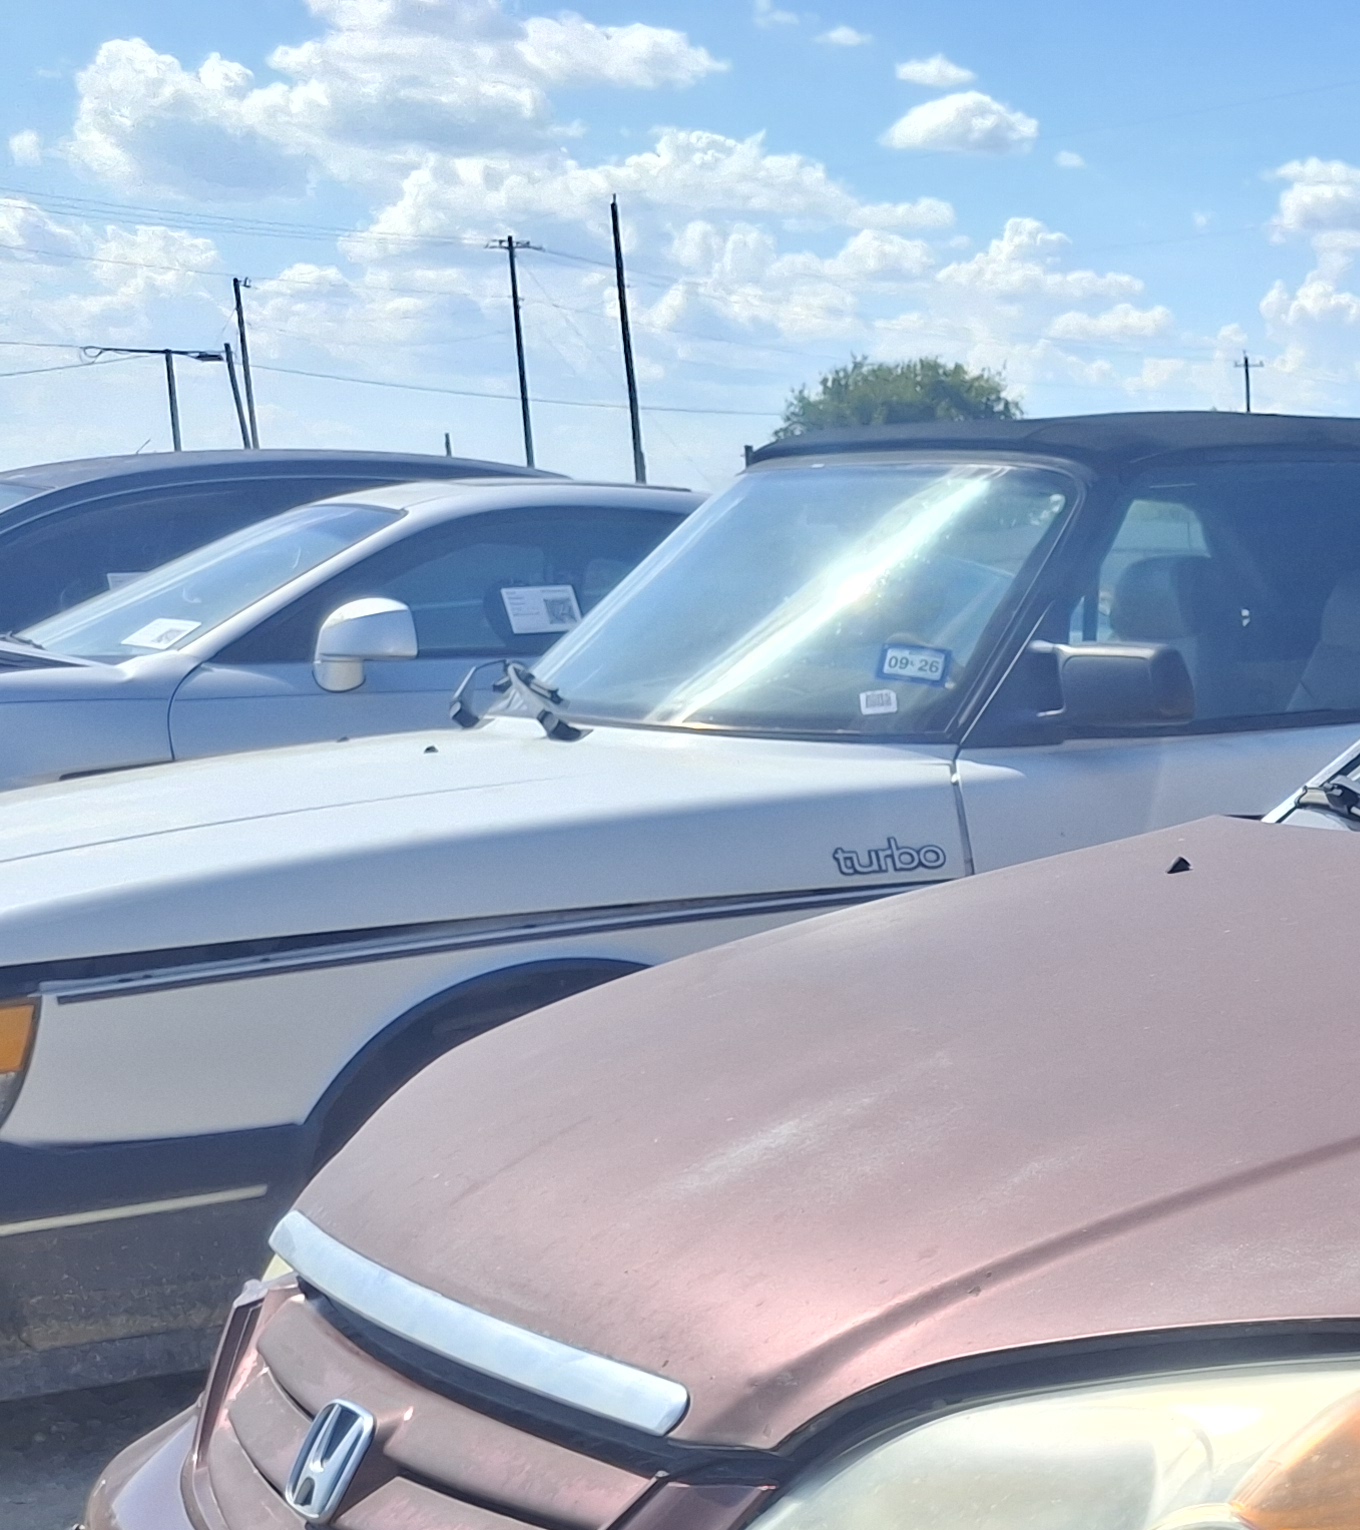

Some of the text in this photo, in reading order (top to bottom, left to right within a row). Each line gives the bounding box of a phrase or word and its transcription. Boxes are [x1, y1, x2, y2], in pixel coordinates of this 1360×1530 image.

[888, 655, 940, 674] 09 26
[832, 836, 946, 876] turbo
